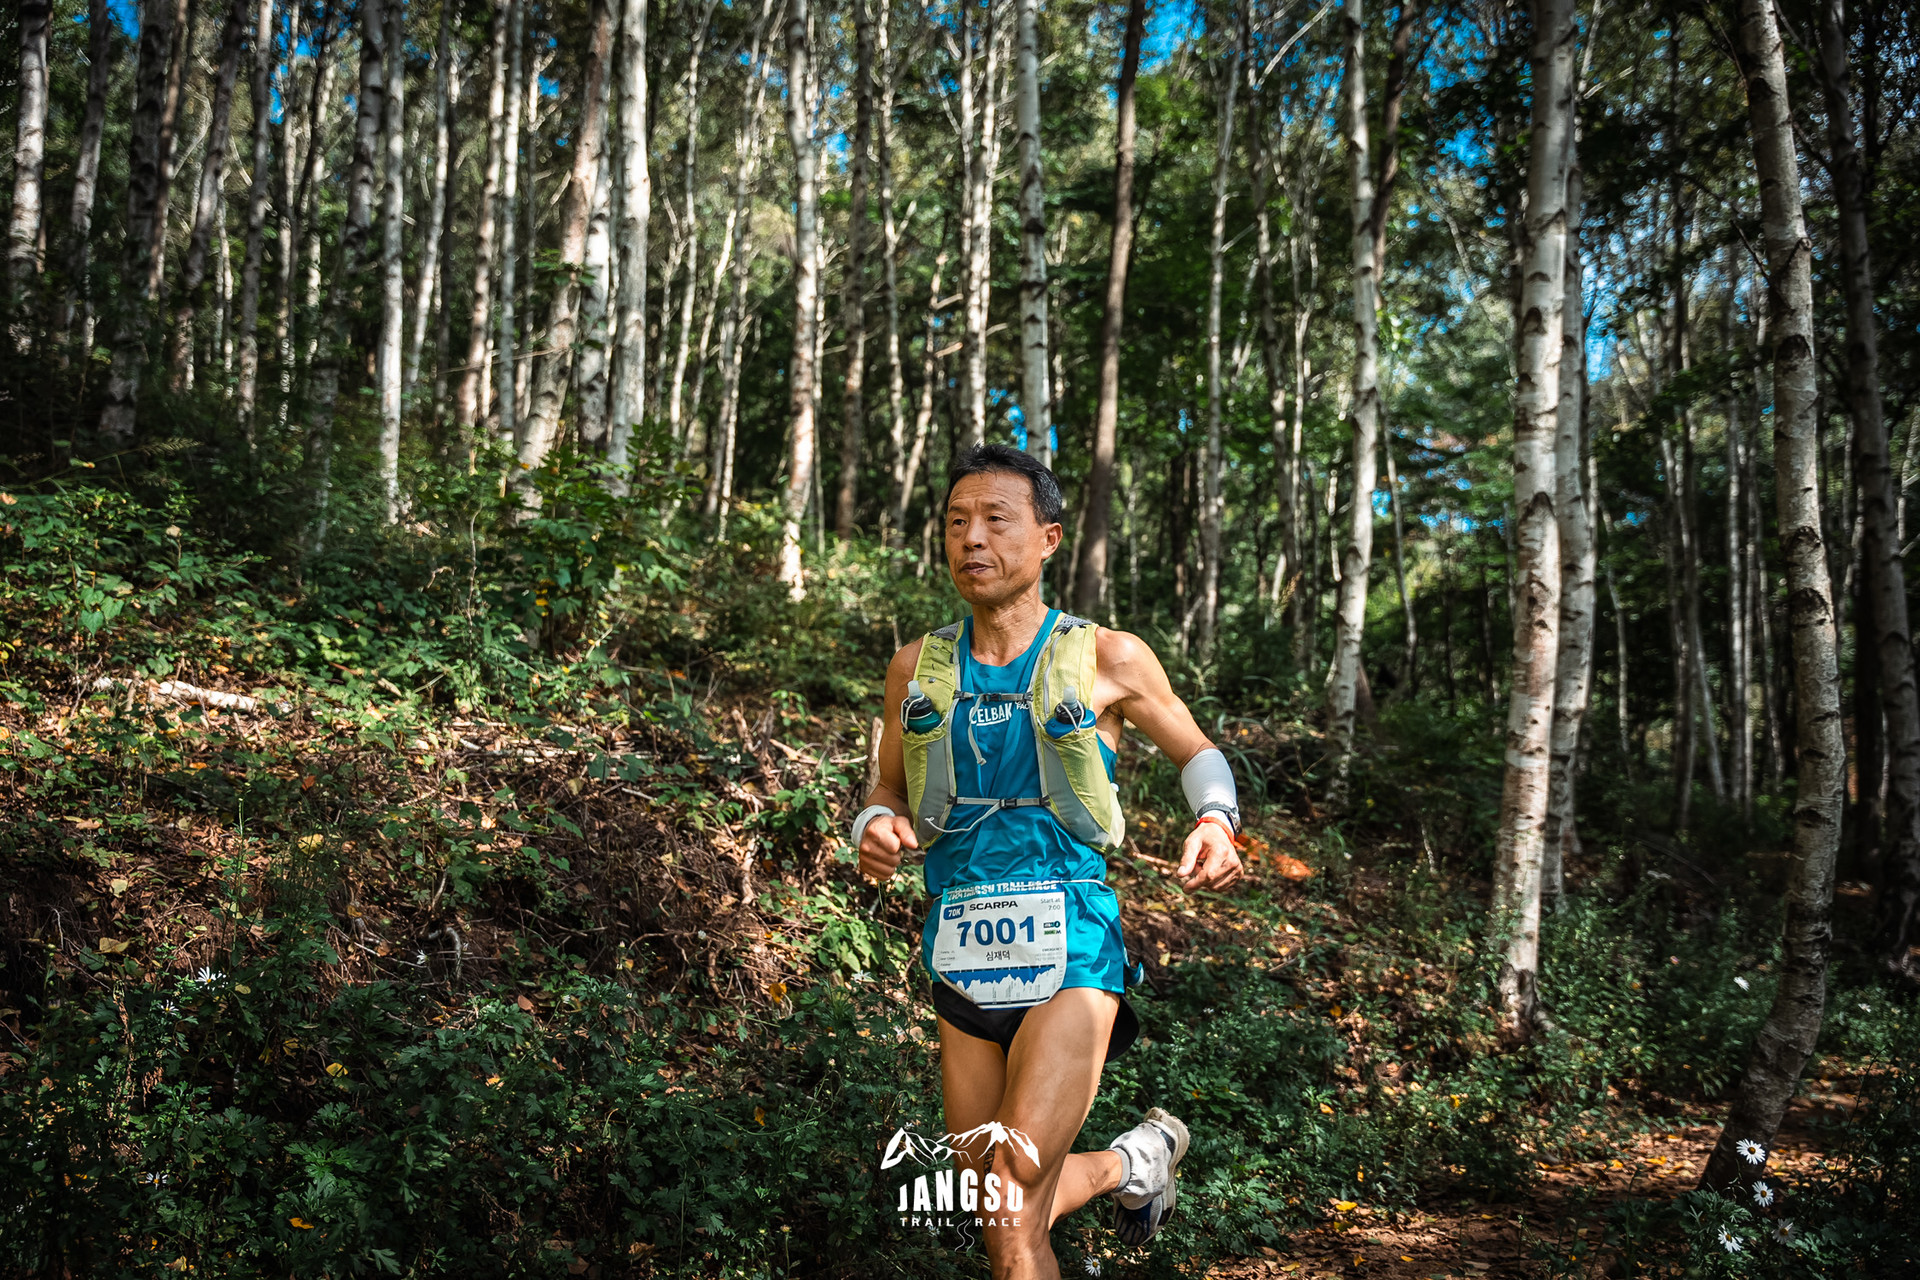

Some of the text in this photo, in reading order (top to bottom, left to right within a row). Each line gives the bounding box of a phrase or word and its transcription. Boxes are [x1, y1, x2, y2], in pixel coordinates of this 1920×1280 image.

[969, 901, 1018, 911] SCARPA
[948, 908, 962, 917] 70K
[956, 916, 1035, 947] 7001
[986, 950, 1010, 961] 심재덕
